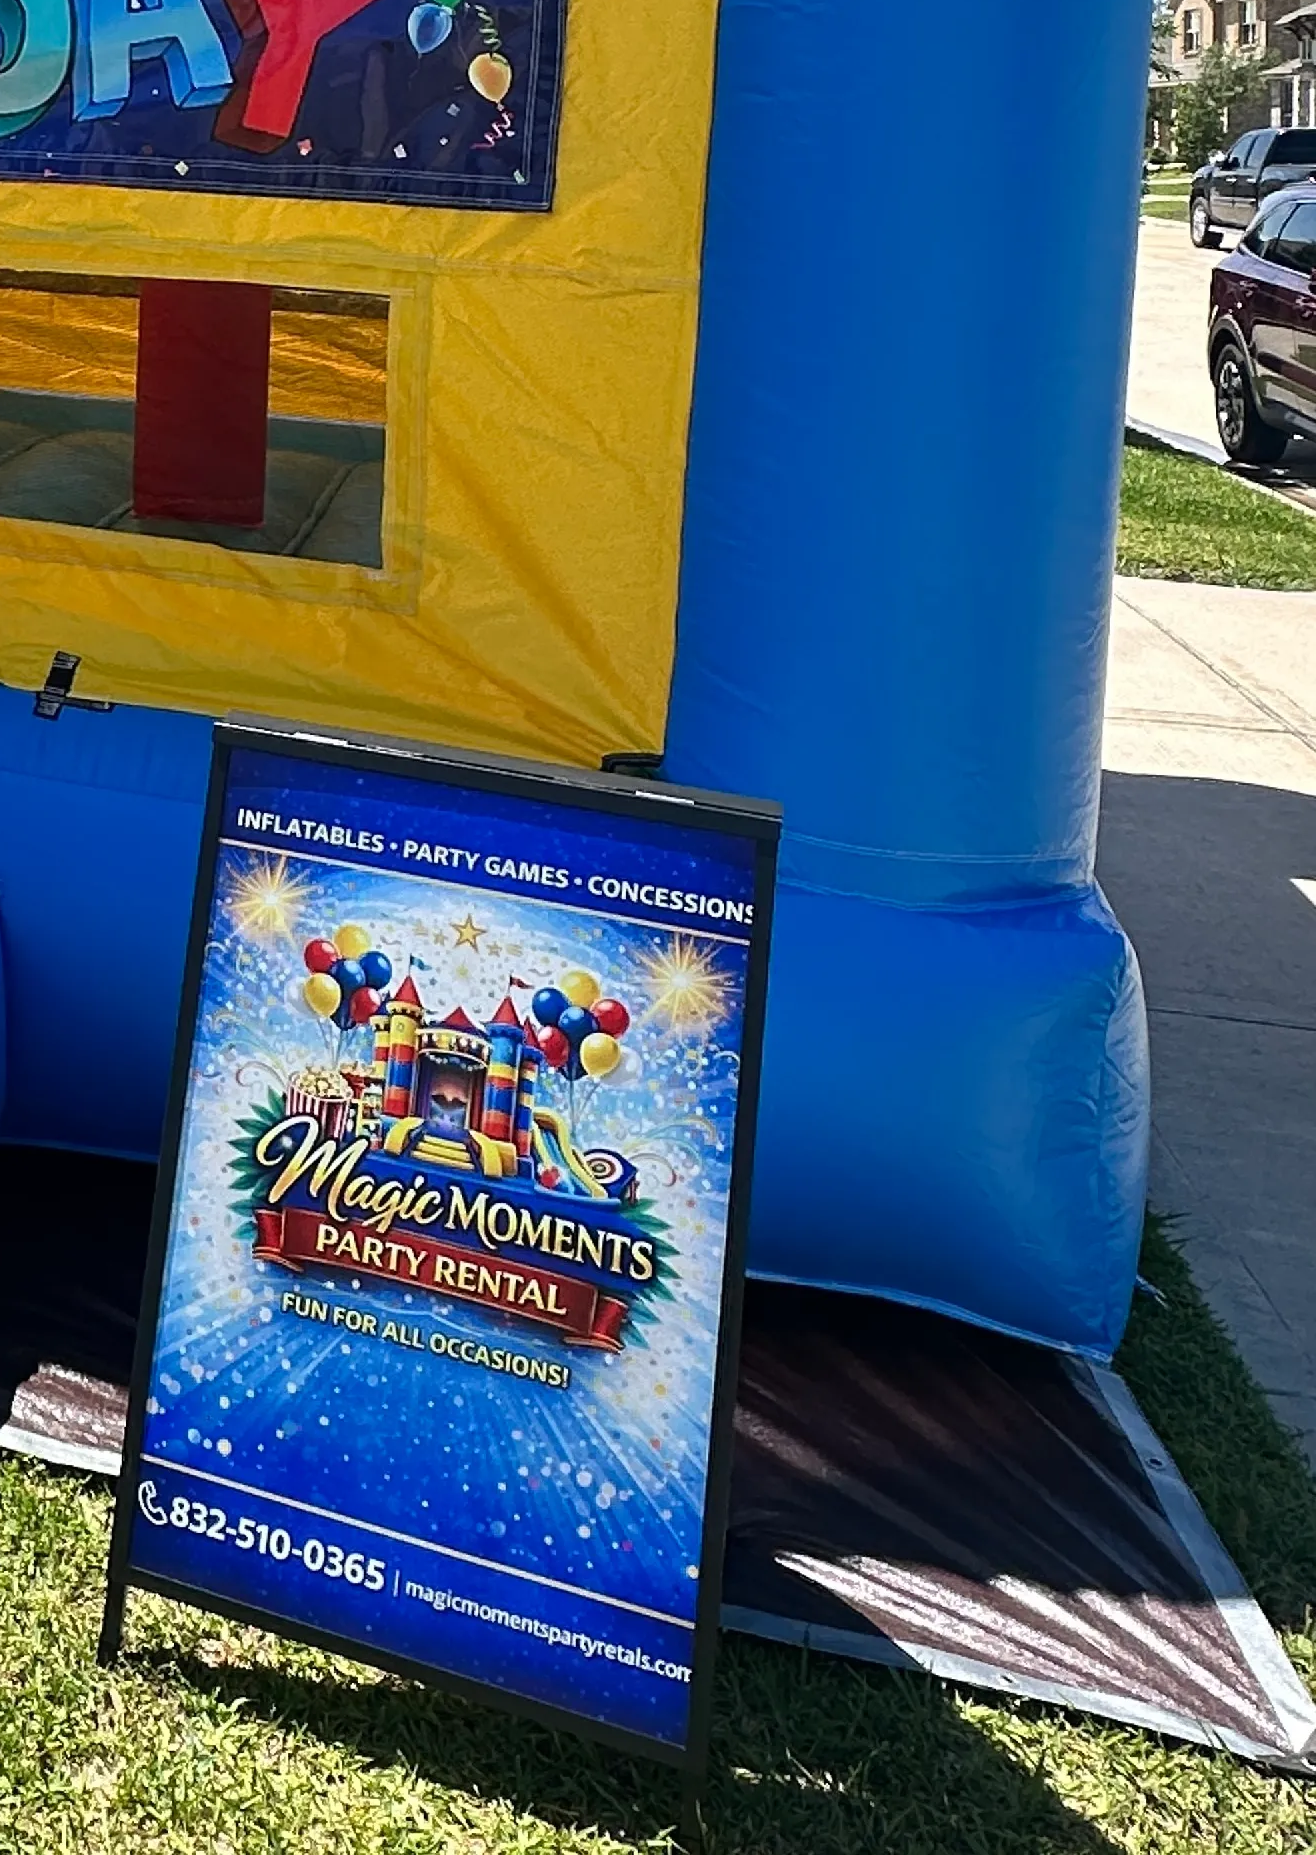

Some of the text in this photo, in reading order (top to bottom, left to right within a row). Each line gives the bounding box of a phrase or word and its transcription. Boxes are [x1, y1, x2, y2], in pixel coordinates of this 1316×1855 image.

[237, 808, 755, 925] INFLATABLES PARTY GAMES CONCESSIONS
[257, 1115, 654, 1281] Magic MOMENTS
[316, 1223, 568, 1316] PARTY RENTAL
[280, 1292, 570, 1389] FUN FOR ALL OCCASIONS!
[169, 1497, 386, 1591] 832-510-0365
